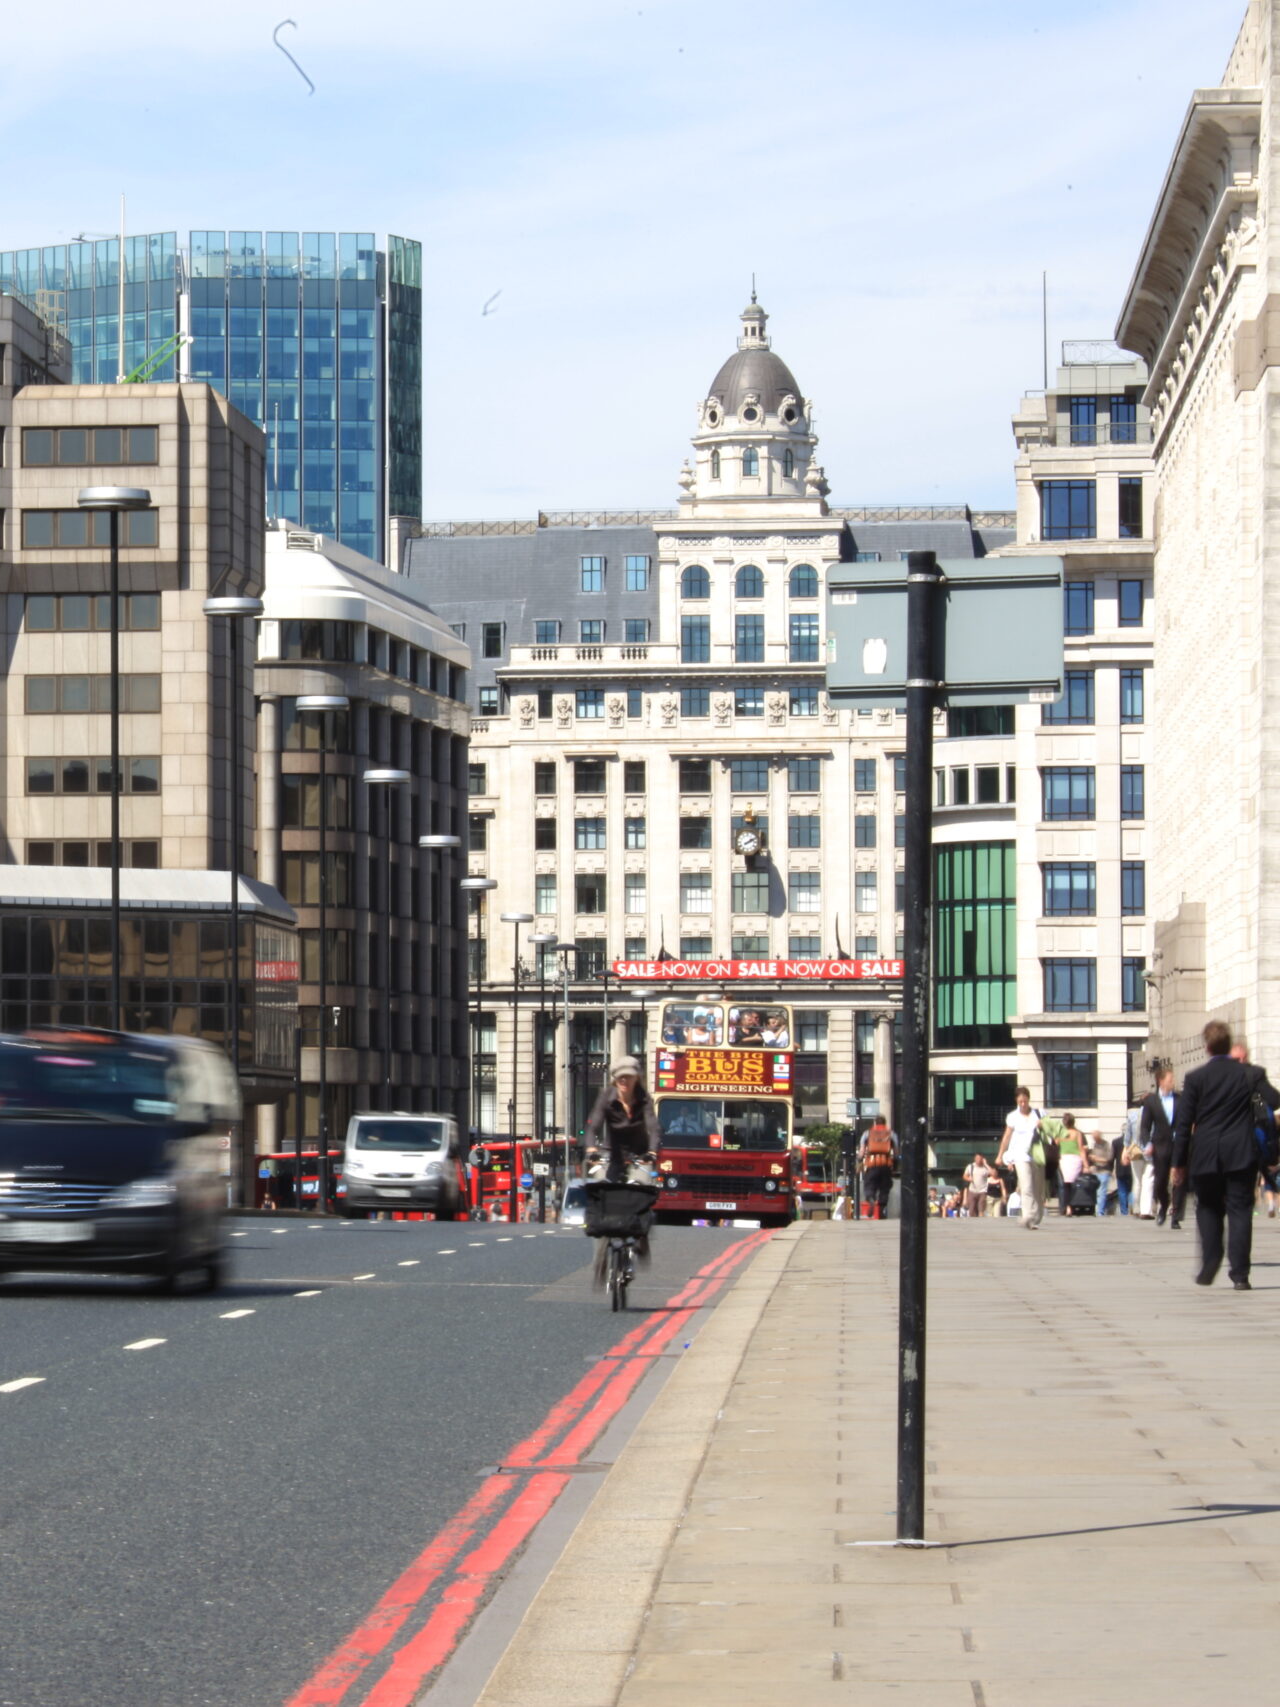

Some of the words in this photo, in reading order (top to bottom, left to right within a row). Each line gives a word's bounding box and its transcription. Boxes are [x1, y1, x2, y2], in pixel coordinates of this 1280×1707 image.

[617, 963, 655, 976] SALE
[662, 963, 701, 976] NOW
[706, 963, 730, 976] ON
[739, 962, 777, 976] SALE
[785, 962, 825, 976] NOW
[829, 962, 854, 976] ON
[861, 962, 900, 976] SALE
[685, 1058, 764, 1075] BUS
[685, 1073, 764, 1082] COMPANY
[676, 1083, 773, 1093] SIGHTSEEING
